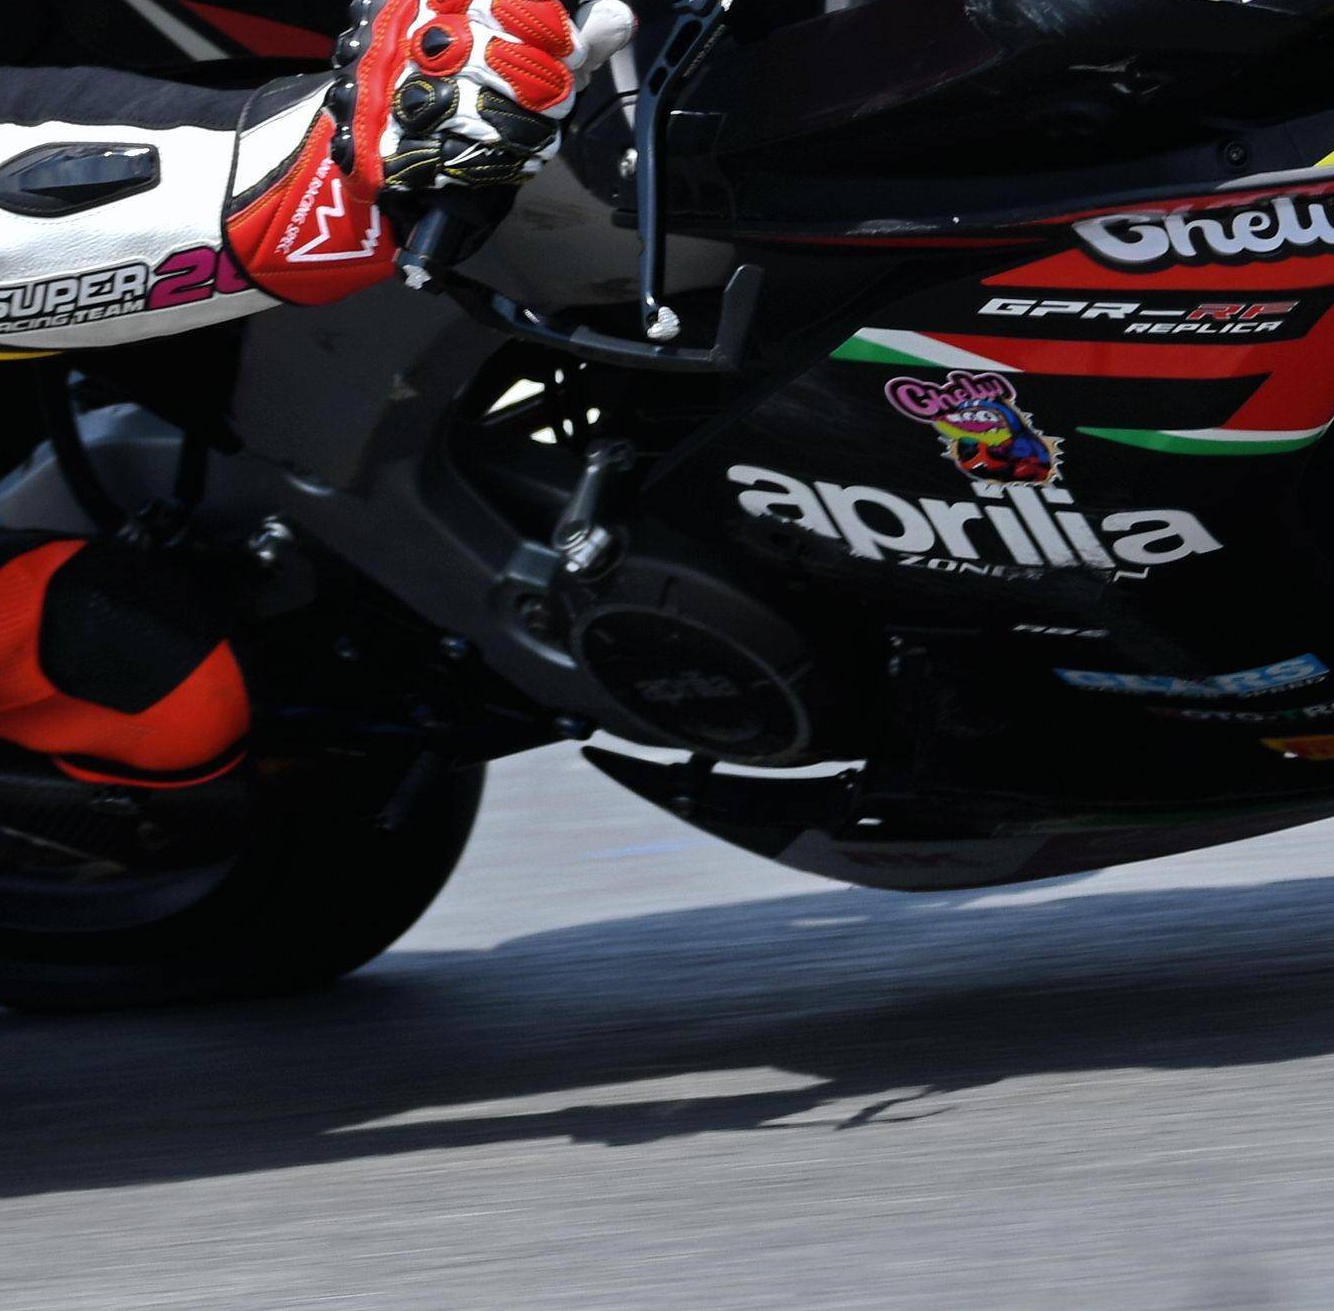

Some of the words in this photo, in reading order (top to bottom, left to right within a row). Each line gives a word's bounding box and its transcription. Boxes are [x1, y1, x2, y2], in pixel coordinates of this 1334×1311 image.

[73, 300, 146, 324] TEAM
[979, 297, 1299, 322] GPR-RF
[1125, 320, 1280, 335] REPLICA
[727, 464, 1223, 569] aprilia
